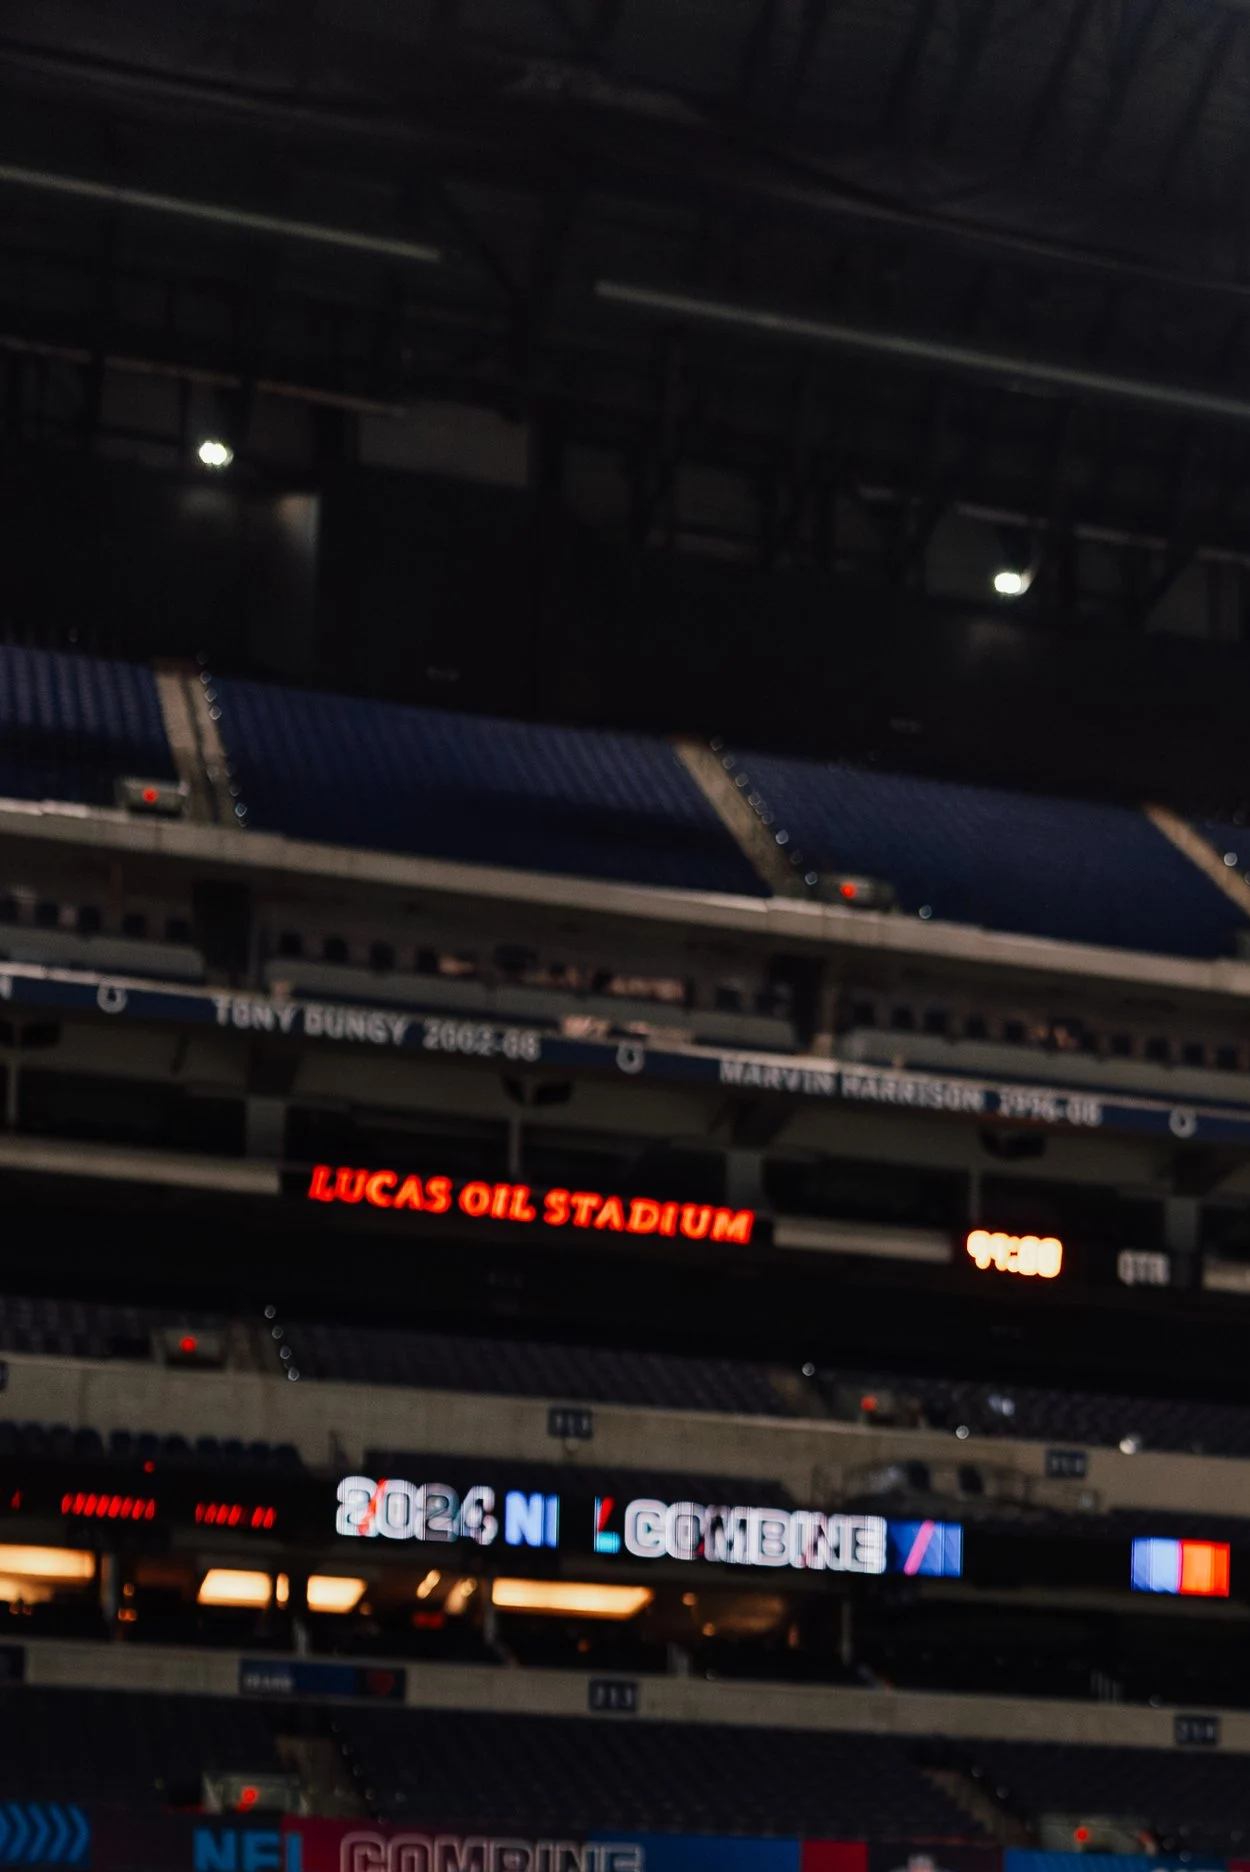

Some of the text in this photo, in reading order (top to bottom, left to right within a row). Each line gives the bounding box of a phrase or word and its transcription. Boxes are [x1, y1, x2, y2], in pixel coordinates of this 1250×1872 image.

[212, 997, 299, 1034] TONY
[303, 1006, 409, 1046] DUNGY
[719, 1060, 836, 1095] MARVIN
[841, 1073, 985, 1113] HARRISON
[309, 1165, 754, 1244] LUCAS OIL STADIUM
[624, 1498, 887, 1574] COMBINE
